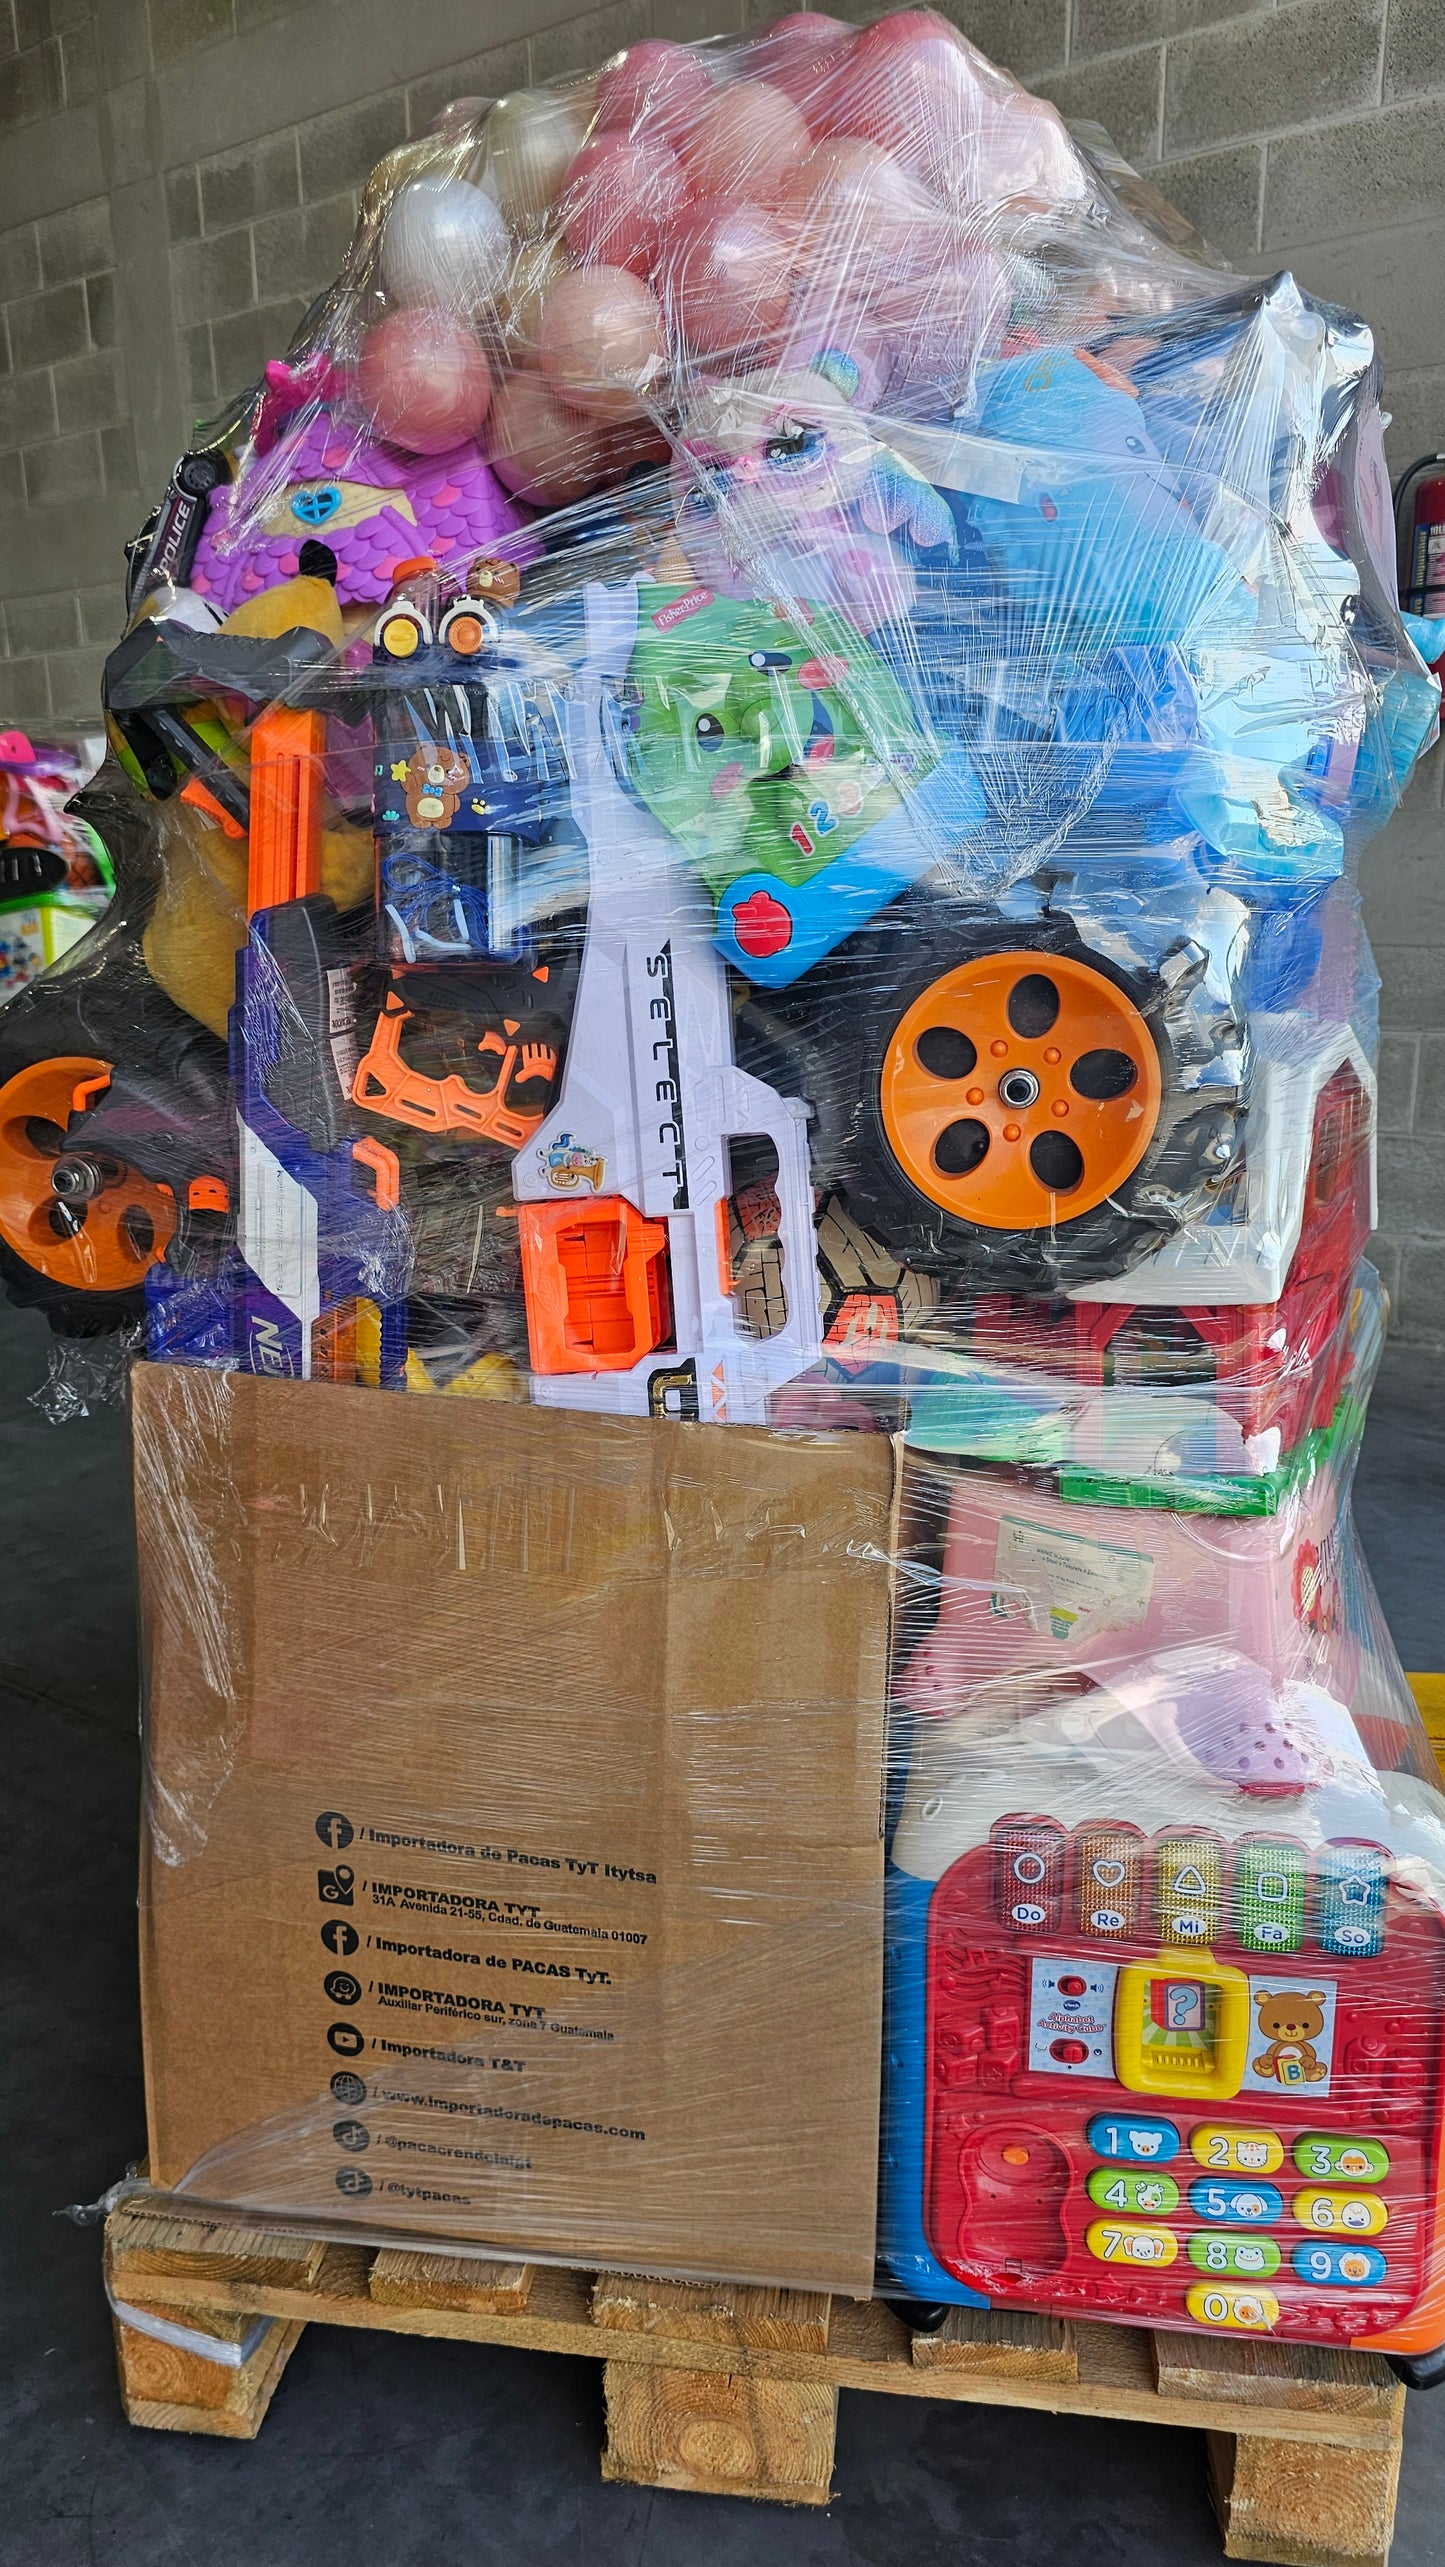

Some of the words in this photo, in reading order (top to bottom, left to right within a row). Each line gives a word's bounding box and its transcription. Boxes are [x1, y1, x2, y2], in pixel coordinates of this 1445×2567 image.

[160, 501, 190, 575] POLICE
[646, 953, 685, 1188] SELECT
[369, 1828, 476, 1857] Importadora
[480, 1846, 502, 1861] de
[507, 1849, 561, 1869] Pacas
[565, 1858, 599, 1876] TyT
[605, 1863, 657, 1884] Itytsa
[372, 1882, 499, 1912] IMPORTADORA
[504, 1902, 540, 1918] TYT
[1017, 1906, 1041, 1922] Do
[372, 1894, 396, 1907] 31A
[400, 1899, 448, 1915] Avenida
[450, 1906, 485, 1922] 21-55,
[488, 1912, 523, 1927] Cdad.
[526, 1918, 541, 1929] de
[544, 1920, 608, 1939] Guatemala
[611, 1930, 648, 1945] 01007
[1098, 1912, 1120, 1928] Re
[1178, 1919, 1200, 1934] Mi
[1261, 1927, 1283, 1942] Fa
[1342, 1930, 1365, 1945] So
[376, 1936, 481, 1965] Importadora
[485, 1954, 507, 1969] de
[512, 1957, 571, 1978] PACAS
[575, 1967, 612, 1985] TyT.
[378, 1982, 506, 2014] IMPORTADORA
[509, 2003, 546, 2019] TYT
[378, 1996, 423, 2012] Auxiliar
[425, 2002, 481, 2021] Periférico
[381, 2038, 485, 2068] Importadora
[1106, 2127, 1118, 2155] 1
[1208, 2137, 1230, 2167] 2
[1310, 2145, 1332, 2175] 3
[1104, 2179, 1128, 2208] 4
[1206, 2187, 1227, 2216] 5
[1311, 2197, 1334, 2228] 6
[1101, 2229, 1123, 2258] 7
[1206, 2240, 1228, 2271] 8
[1309, 2250, 1332, 2280] 9
[1203, 2292, 1229, 2322] 0
